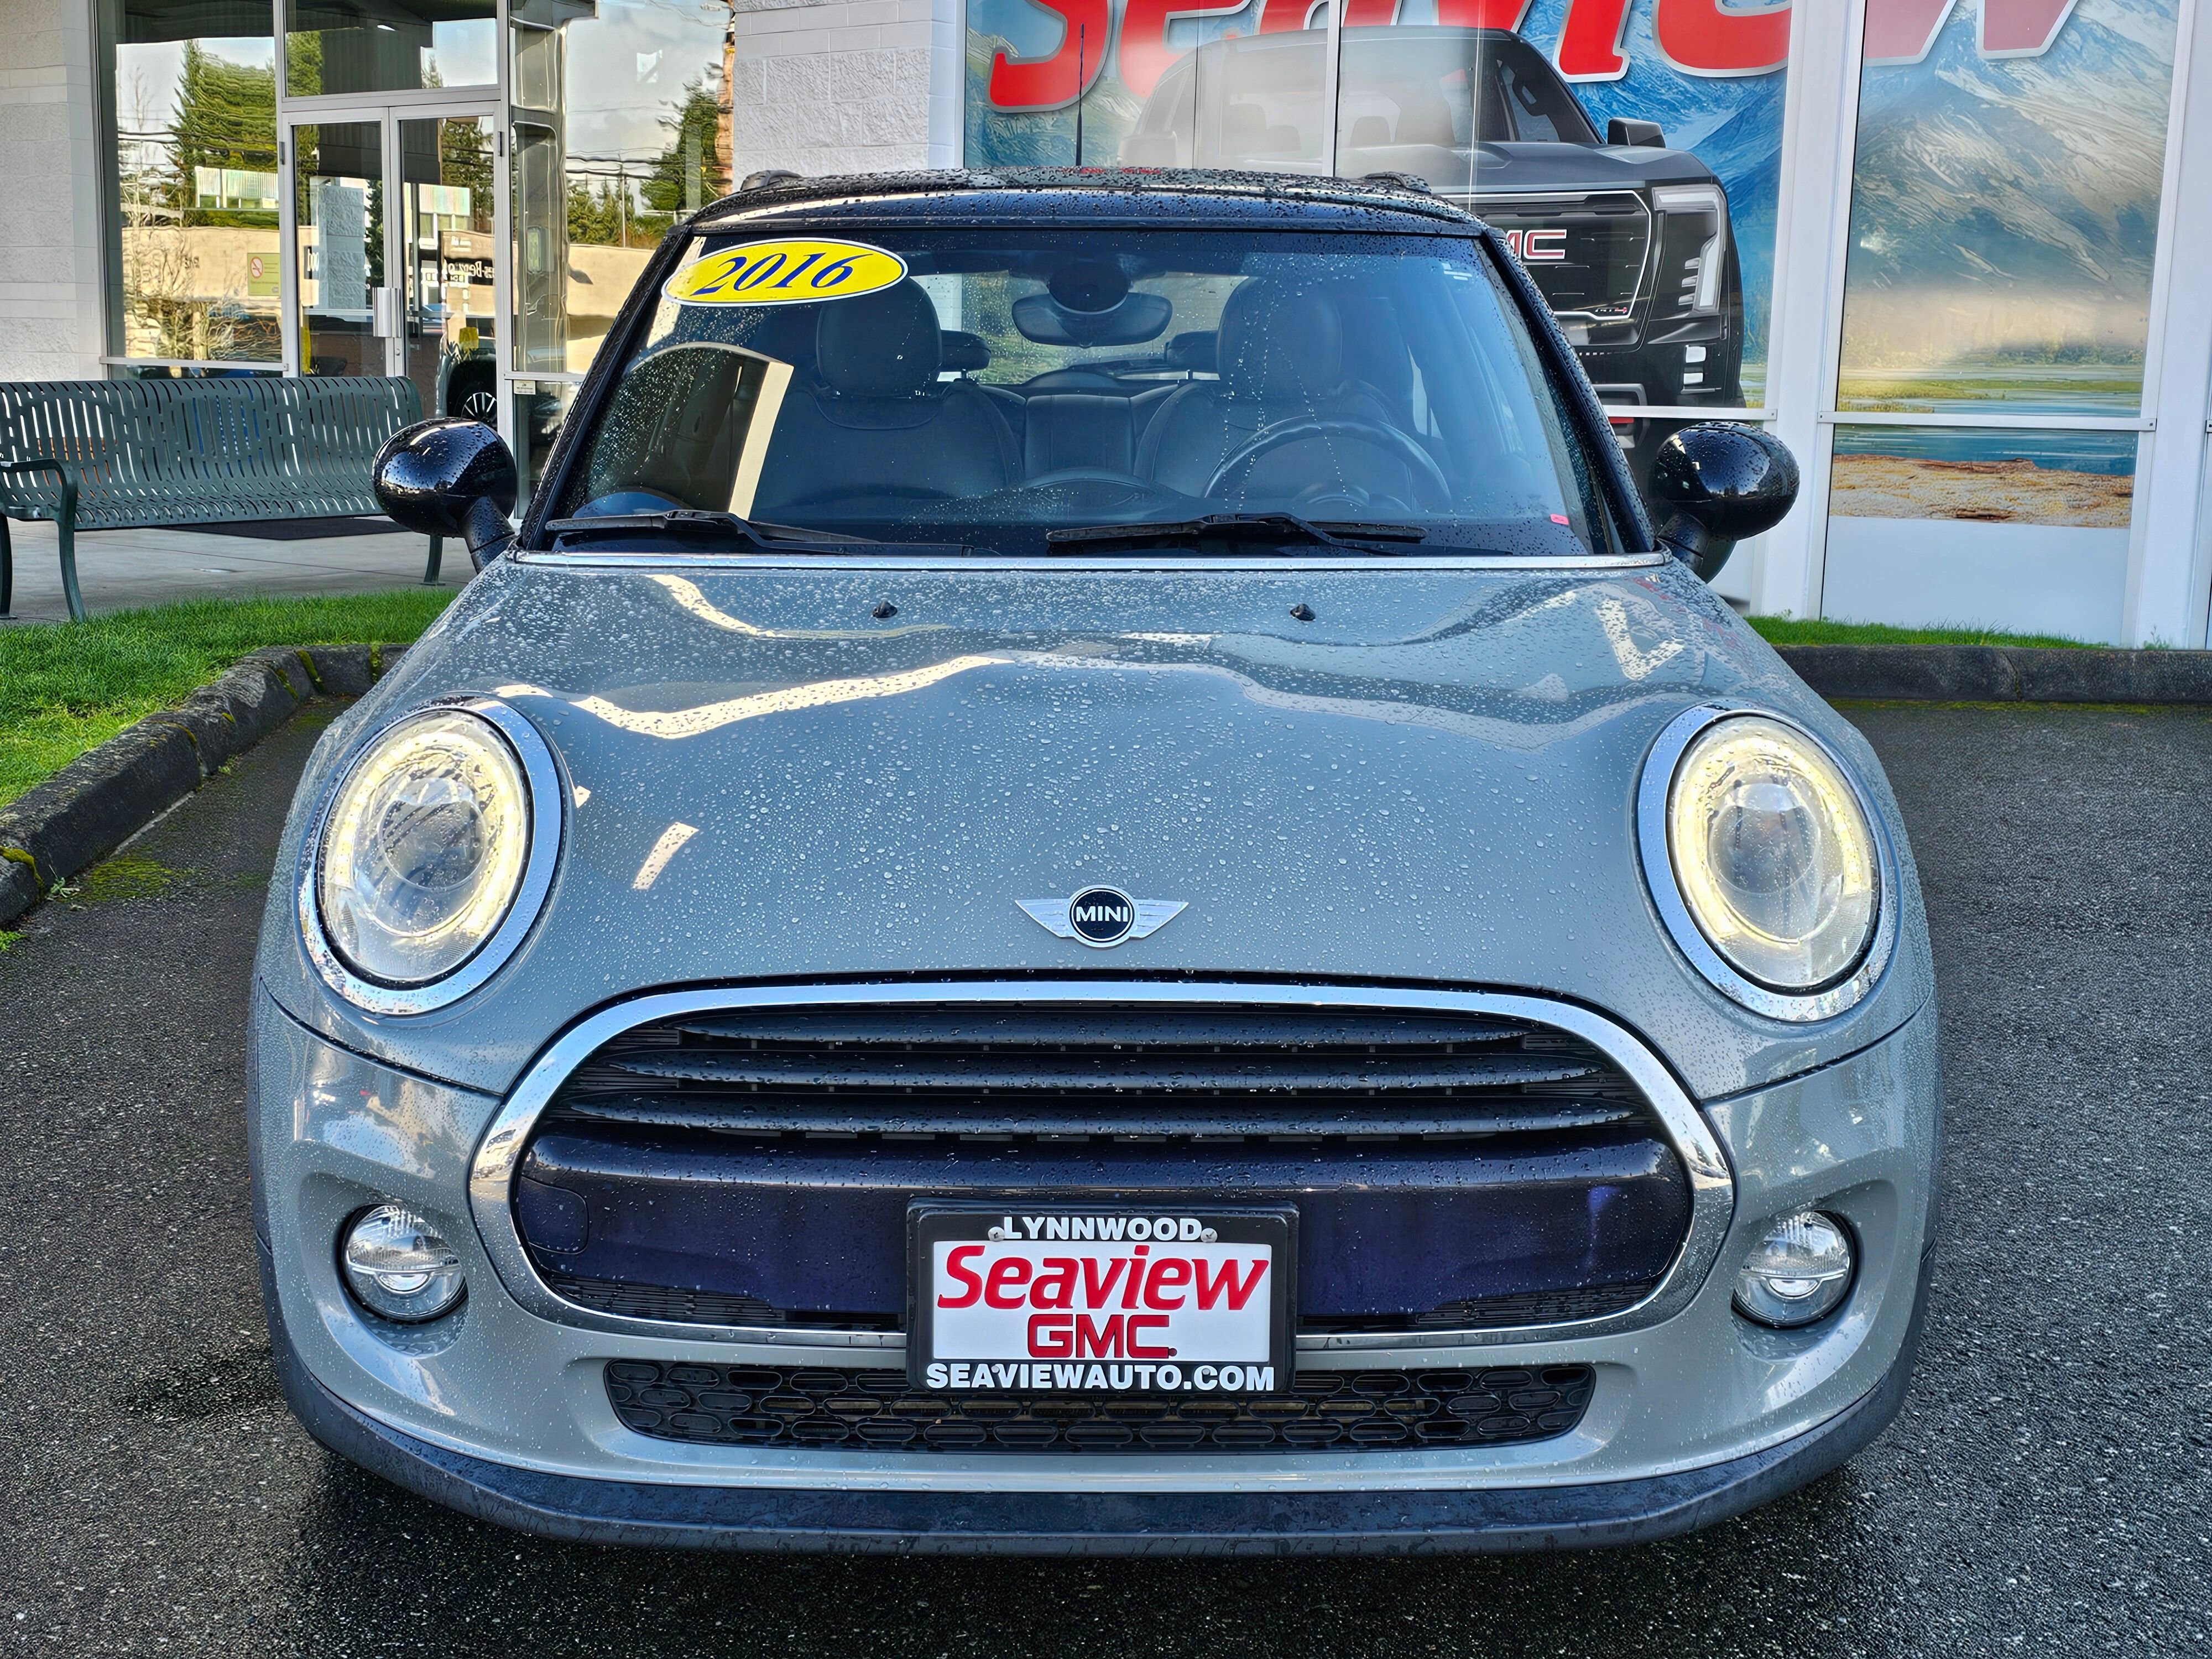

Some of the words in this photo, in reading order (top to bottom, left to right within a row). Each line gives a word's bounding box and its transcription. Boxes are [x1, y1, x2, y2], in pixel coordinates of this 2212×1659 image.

[689, 252, 874, 297] 2016
[1076, 906, 1128, 922] MINI
[1004, 1217, 1202, 1240] LYNNWOOD
[937, 1245, 1269, 1311] Seaview
[1027, 1314, 1170, 1359] GMC
[926, 1363, 1274, 1391] SEAVIEWAUTO.COM
